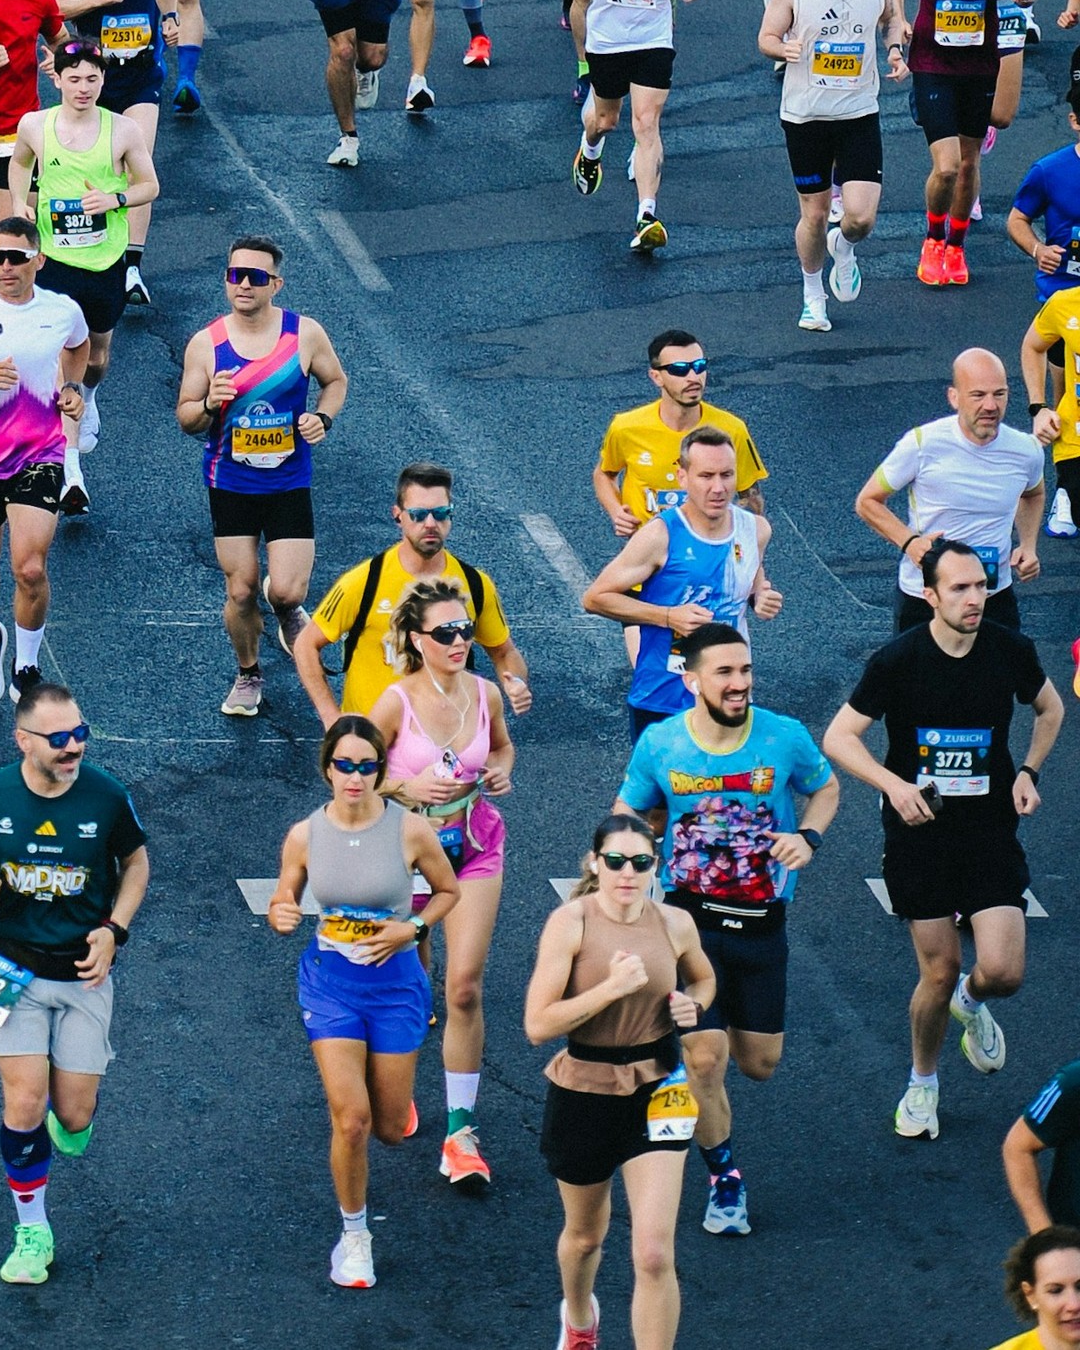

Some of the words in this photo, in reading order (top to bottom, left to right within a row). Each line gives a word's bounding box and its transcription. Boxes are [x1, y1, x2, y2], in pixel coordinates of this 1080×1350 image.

[946, 15, 978, 28] 26705
[111, 30, 143, 44] 25316
[823, 57, 856, 70] 24923
[254, 415, 287, 427] ZURICH
[244, 433, 283, 447] 24640
[944, 733, 984, 744] ZURICH
[934, 751, 973, 769] 3773
[669, 769, 724, 796] DRAGON
[0, 862, 87, 896] MADRID
[721, 918, 743, 930] FILA
[663, 1088, 692, 1109] 245
